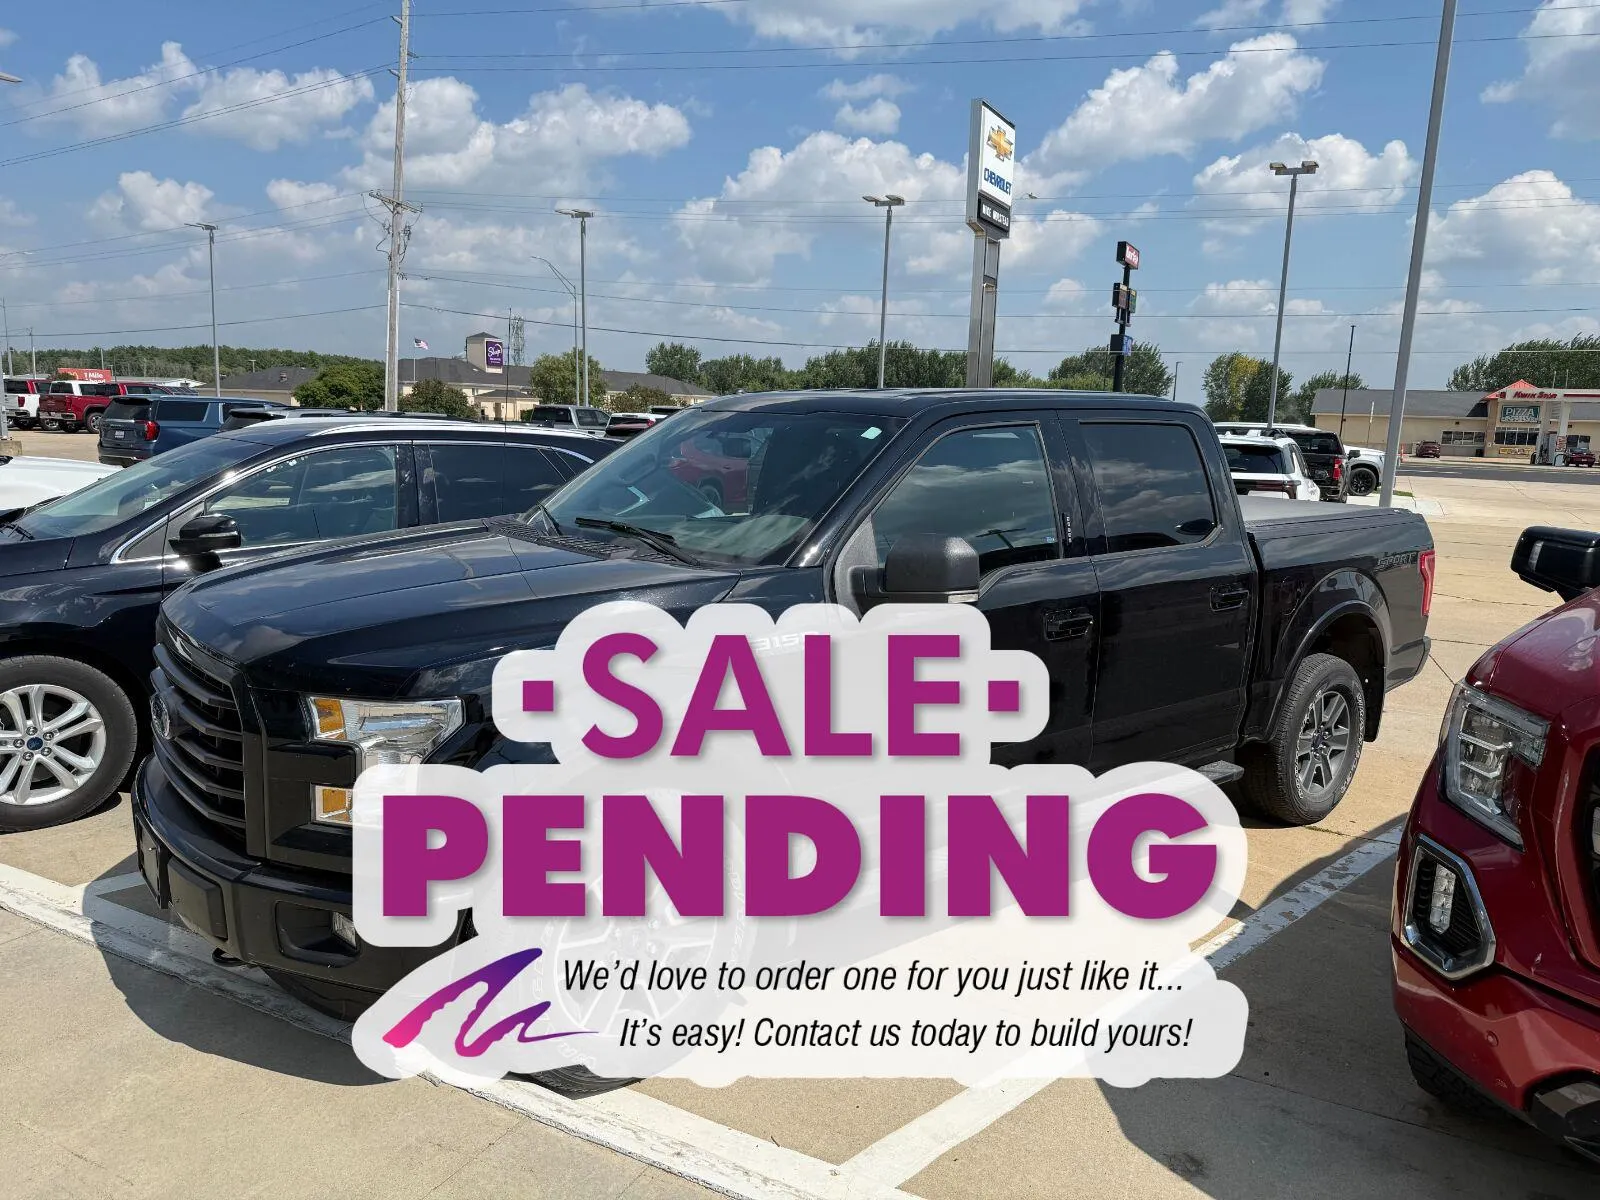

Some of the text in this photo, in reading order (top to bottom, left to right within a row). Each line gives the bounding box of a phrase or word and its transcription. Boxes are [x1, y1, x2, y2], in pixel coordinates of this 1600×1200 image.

[984, 167, 1012, 195] CHEVROLET
[1506, 407, 1534, 416] PIZZA
[1377, 551, 1418, 567] SPORT
